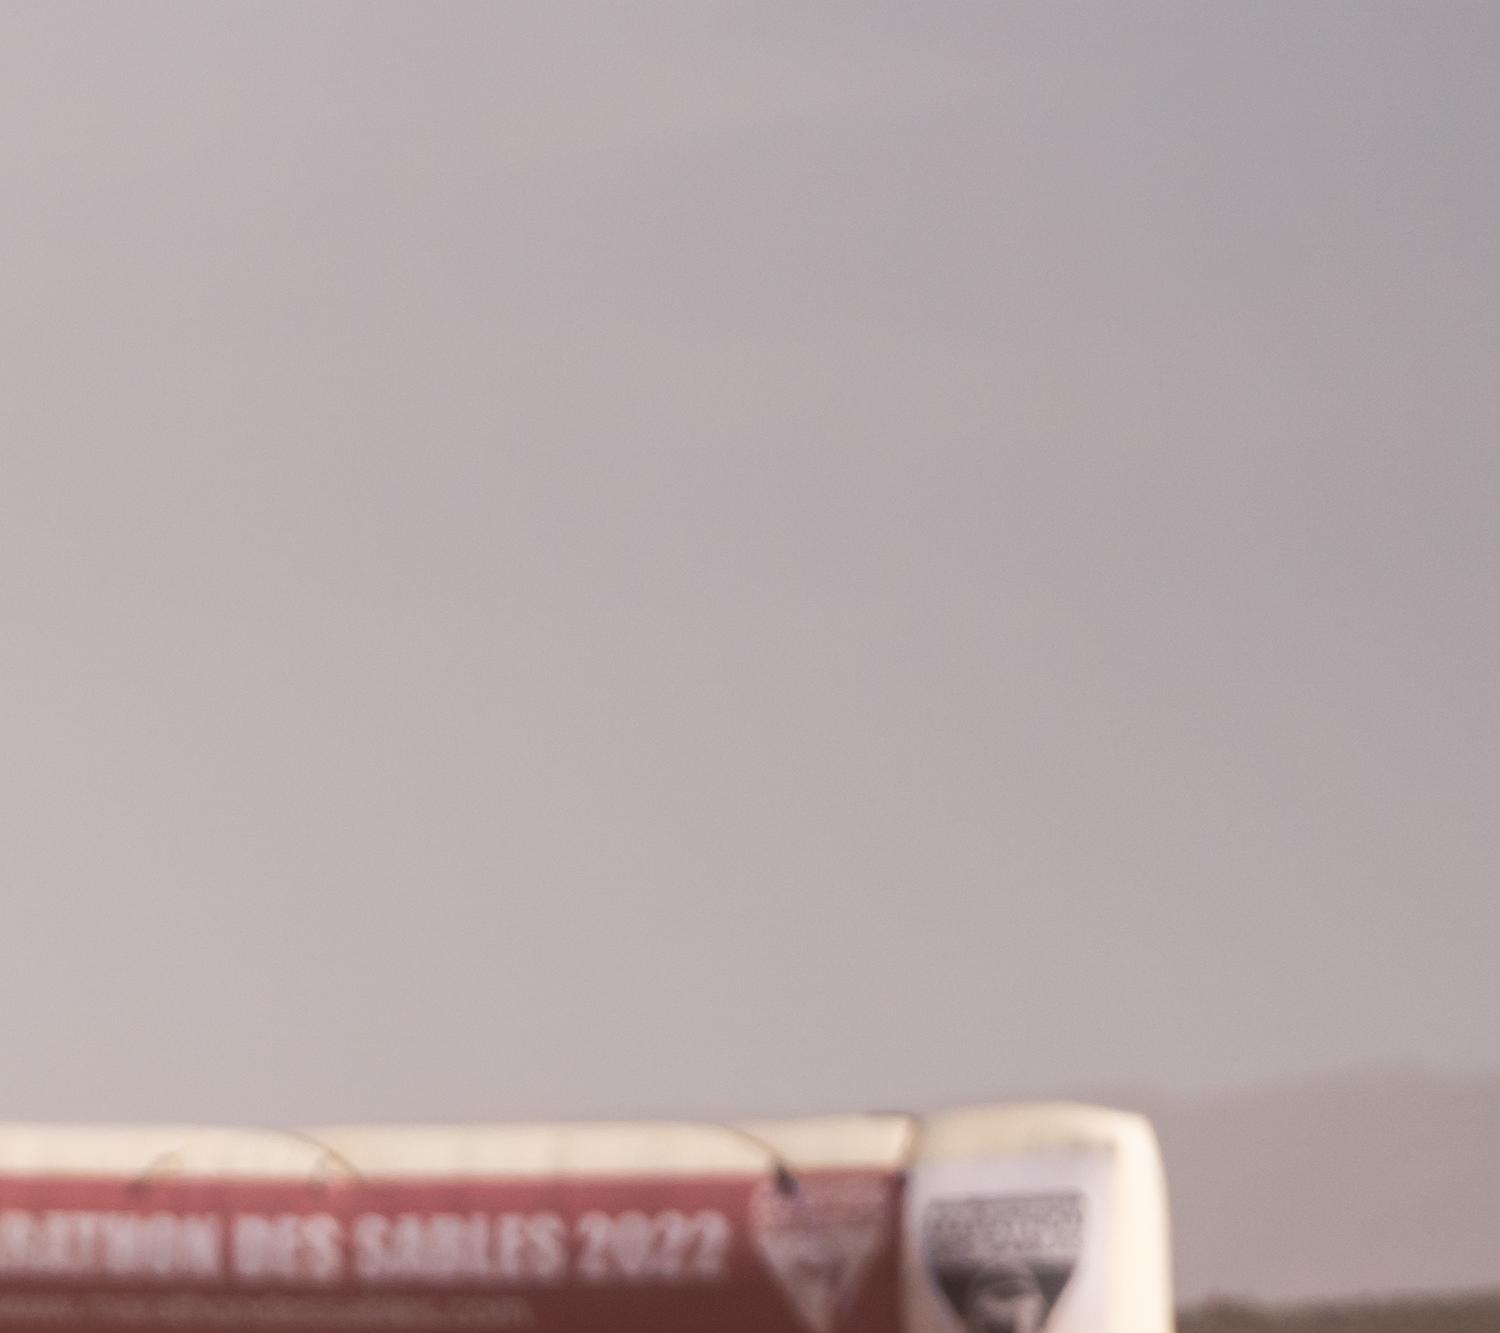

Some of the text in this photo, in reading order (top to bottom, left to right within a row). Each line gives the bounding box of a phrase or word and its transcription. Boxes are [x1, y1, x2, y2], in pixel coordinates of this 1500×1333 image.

[231, 1212, 345, 1282] DES
[354, 1210, 567, 1282] SABLES
[576, 1208, 732, 1280] 2022
